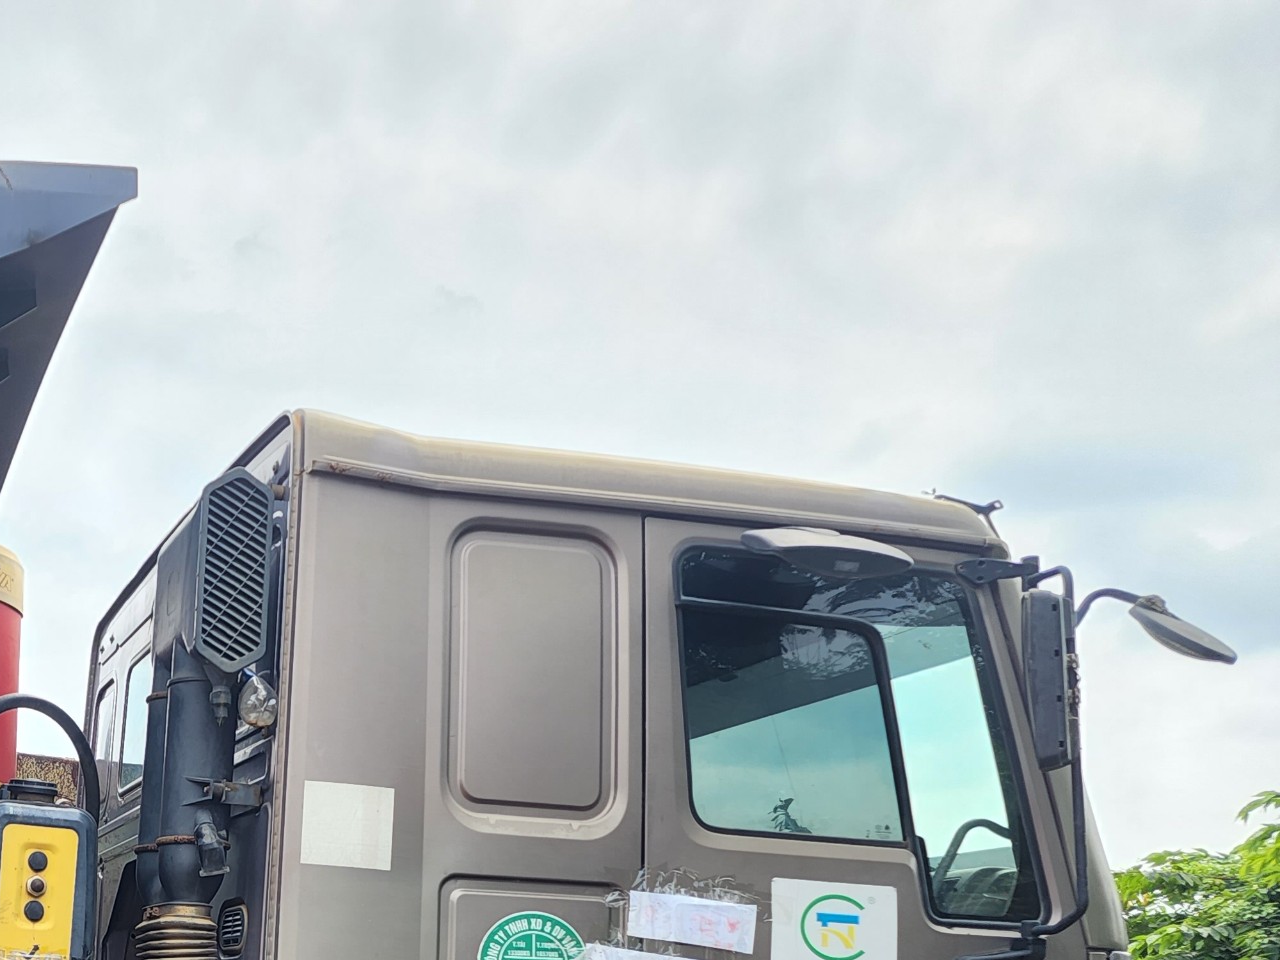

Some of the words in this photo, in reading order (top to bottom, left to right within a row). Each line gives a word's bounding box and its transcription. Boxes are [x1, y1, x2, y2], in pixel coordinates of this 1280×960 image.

[494, 930, 508, 944] TY
[504, 918, 529, 936] TNHH
[530, 918, 543, 929] XD
